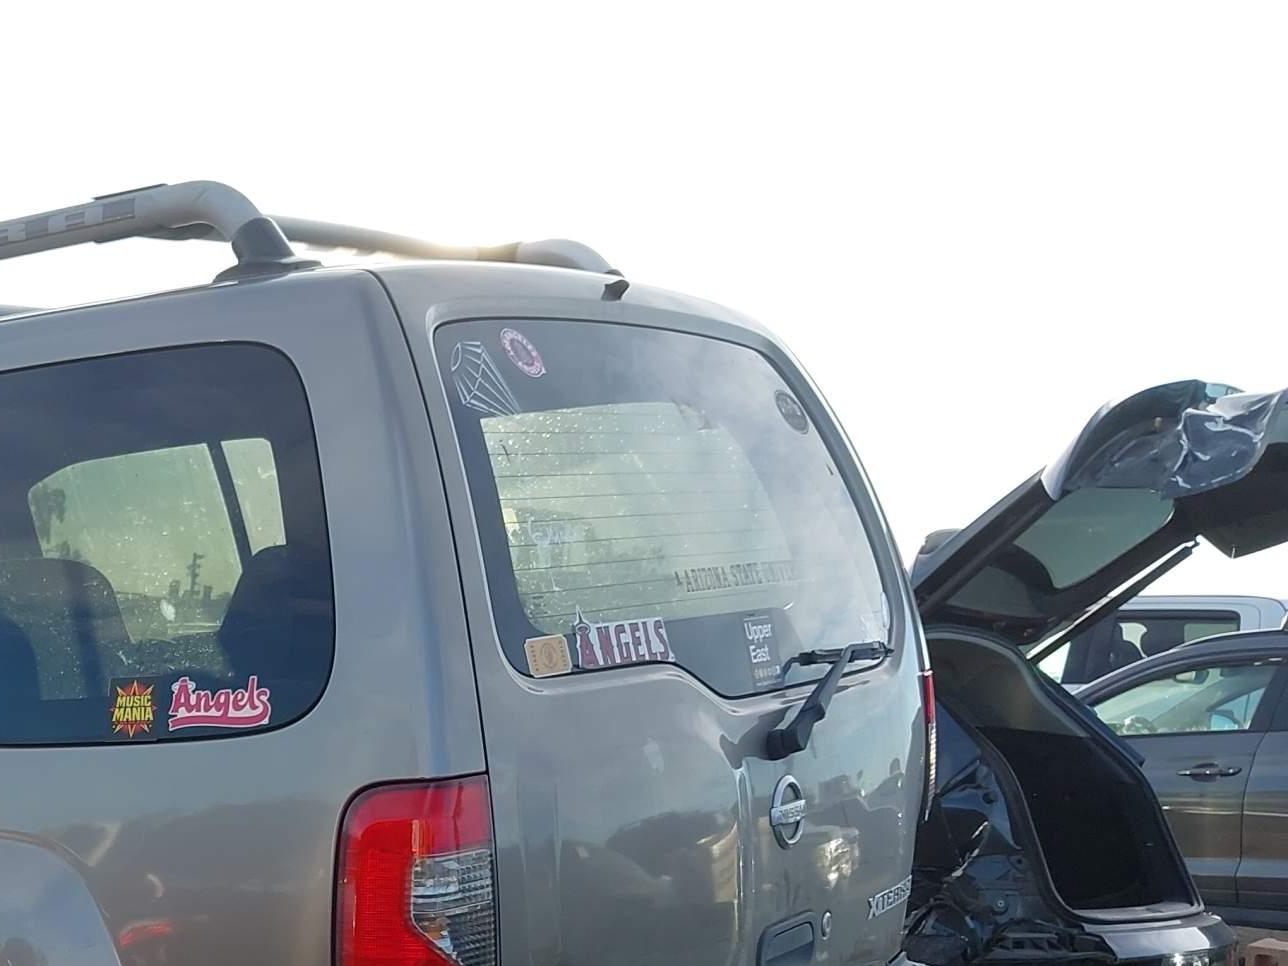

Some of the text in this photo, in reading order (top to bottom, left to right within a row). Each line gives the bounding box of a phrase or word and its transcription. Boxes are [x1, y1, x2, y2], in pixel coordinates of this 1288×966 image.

[684, 565, 732, 593] ARIZONA
[730, 562, 762, 587] STATE
[577, 612, 671, 669] ANGELS
[744, 622, 772, 643] Upper
[749, 644, 770, 663] East
[116, 695, 151, 708] MUSIC
[169, 676, 271, 722] Angels
[113, 707, 154, 721] MANIA
